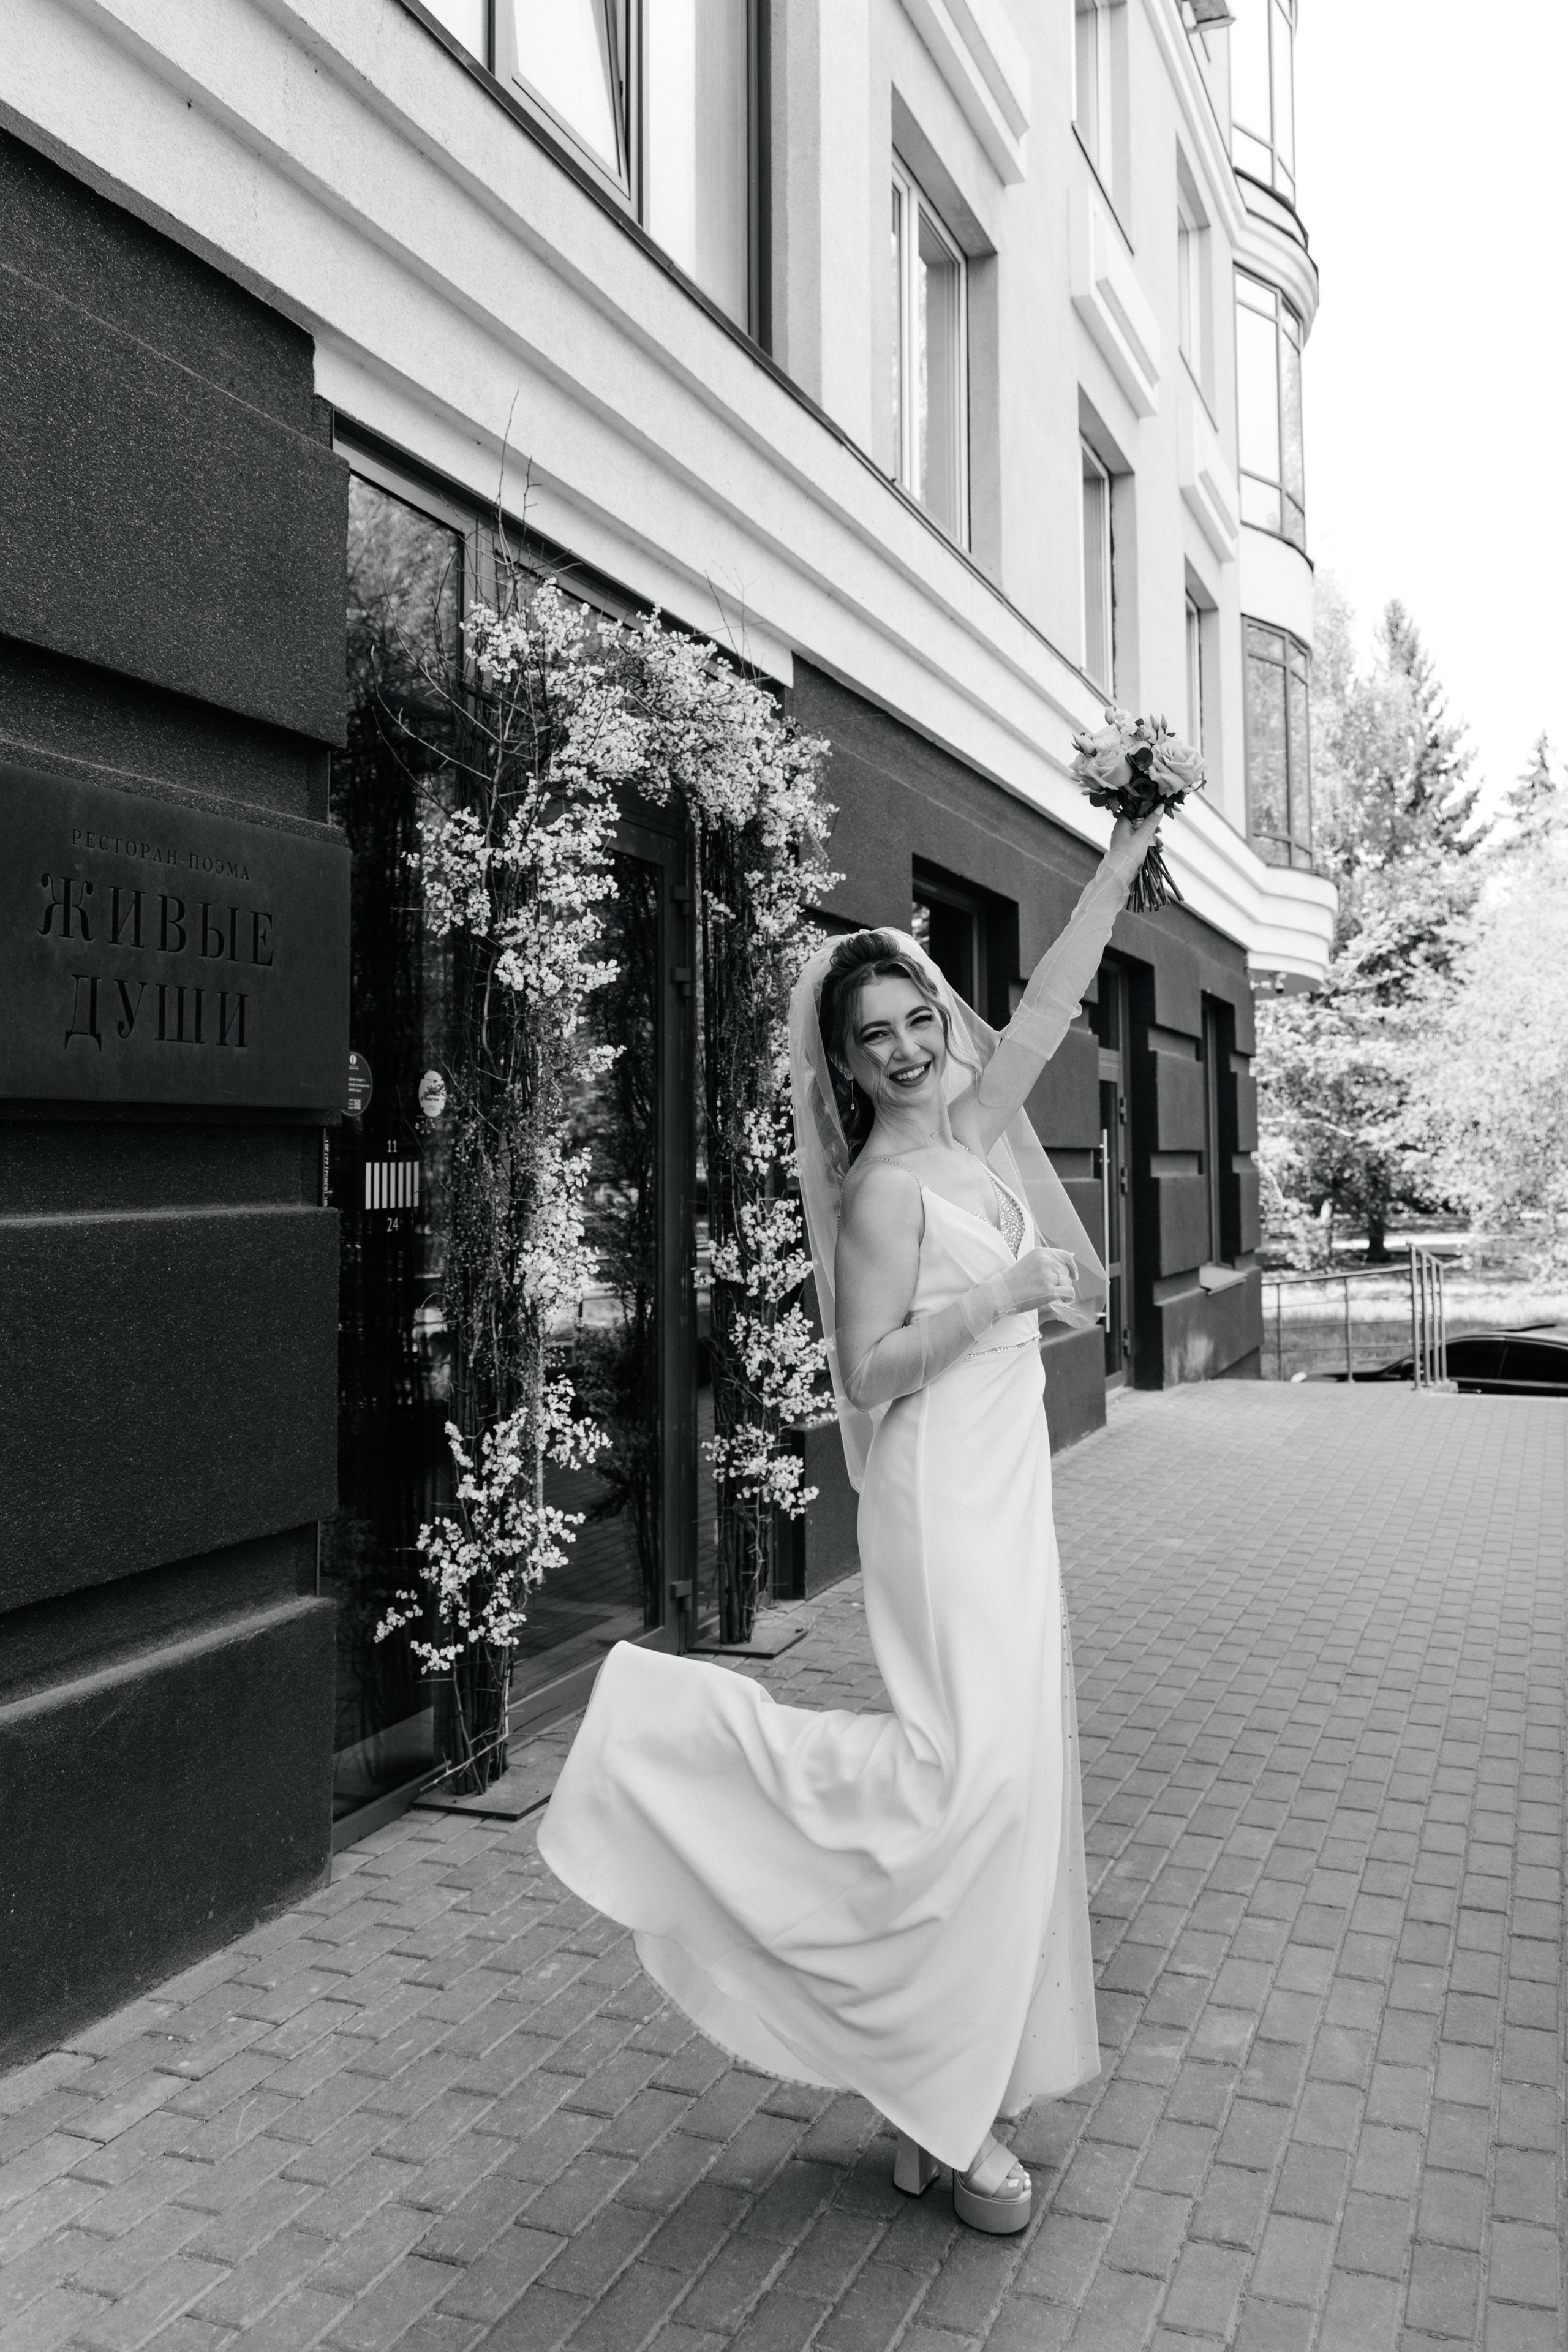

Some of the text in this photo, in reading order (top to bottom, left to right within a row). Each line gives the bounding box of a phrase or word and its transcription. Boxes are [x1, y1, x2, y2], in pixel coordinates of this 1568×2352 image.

[70, 828, 251, 881] РЕСТОРАН-ПОЭМА
[37, 872, 274, 967] ЖИВЫЕ
[64, 974, 249, 1052] ДУШИ
[387, 1140, 398, 1153] 11
[386, 1217, 399, 1232] 24
